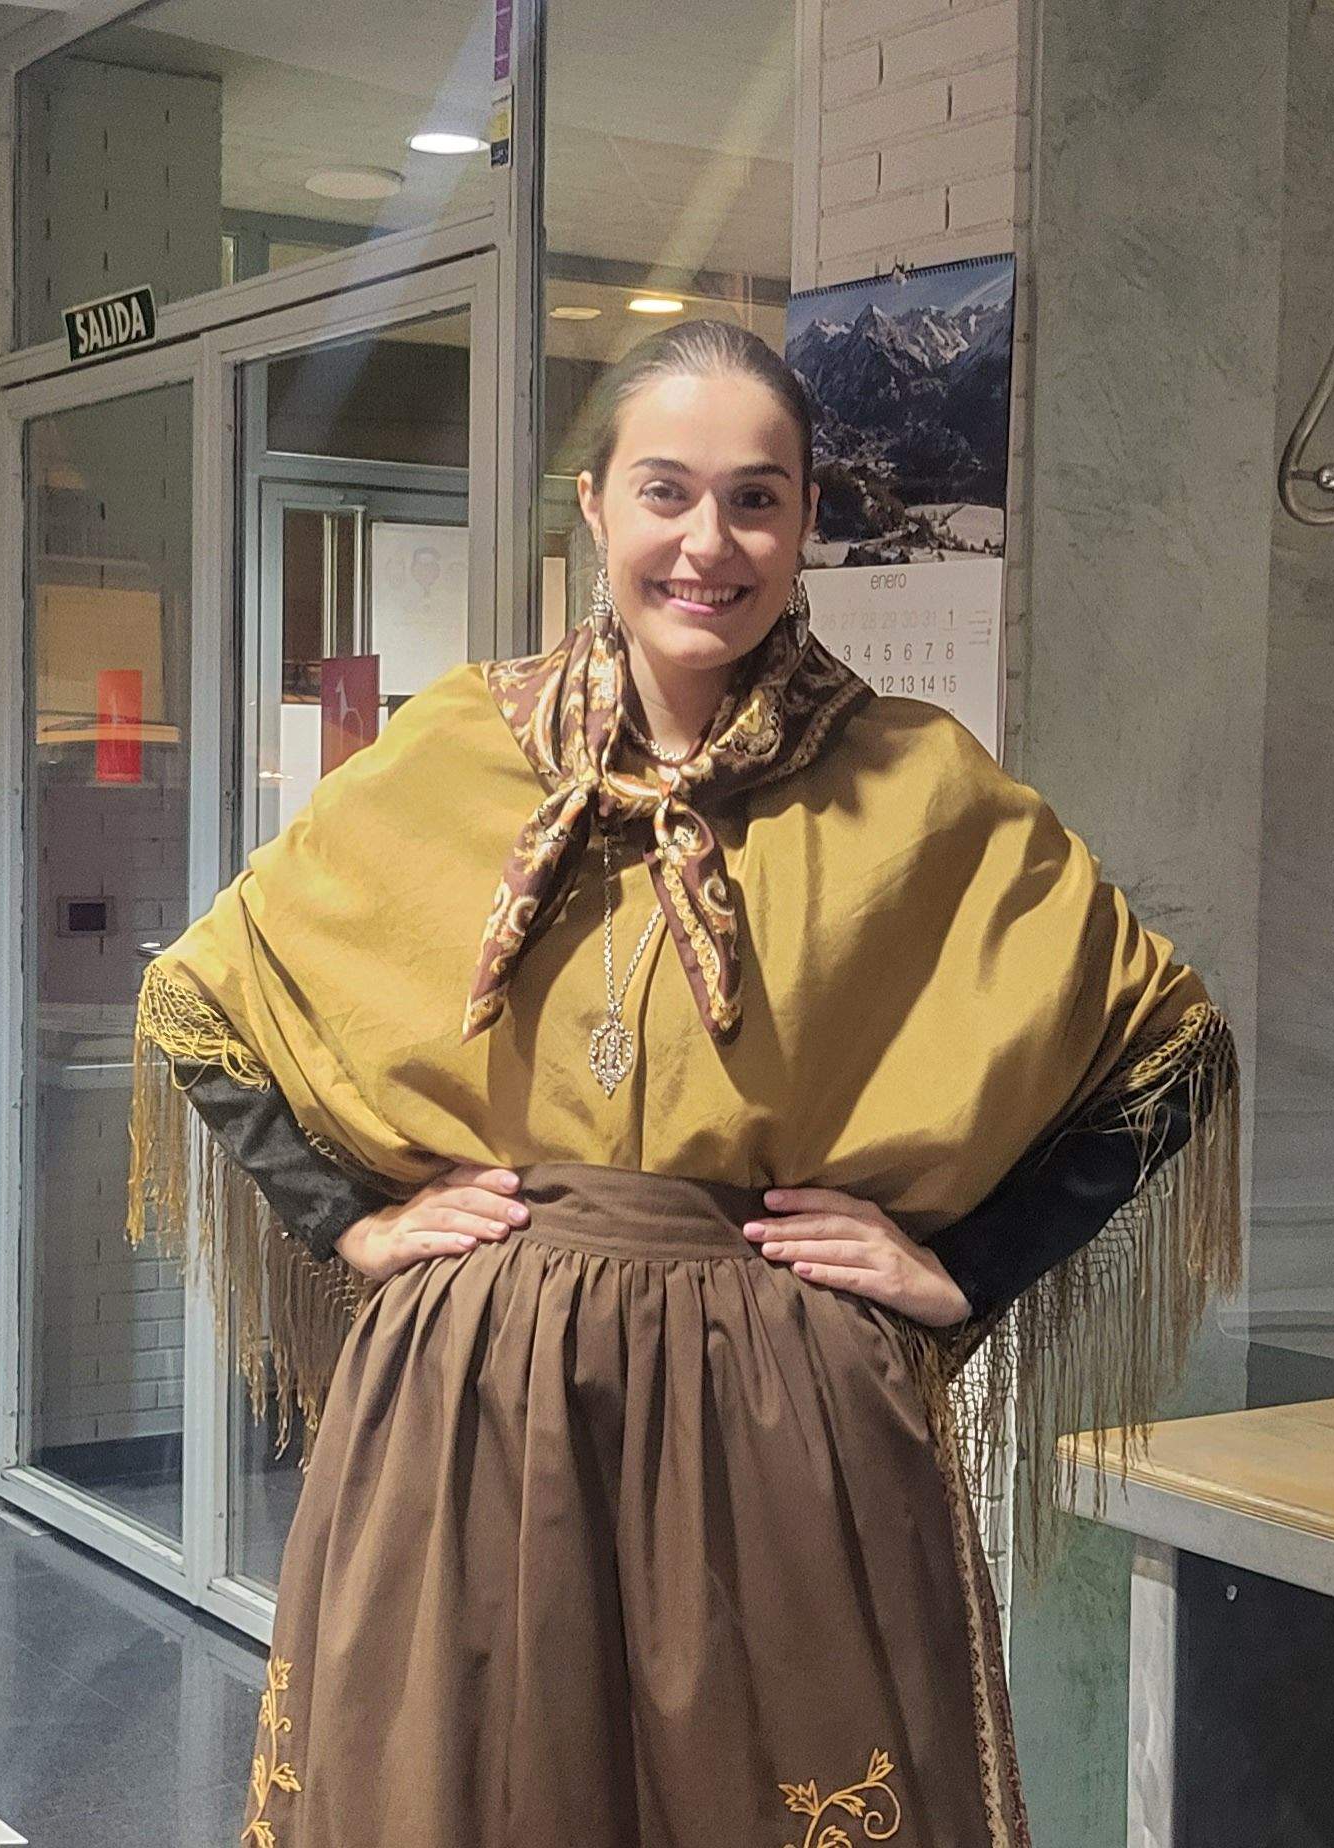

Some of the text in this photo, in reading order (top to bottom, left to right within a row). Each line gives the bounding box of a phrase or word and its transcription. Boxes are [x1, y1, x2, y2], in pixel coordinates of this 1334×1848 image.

[75, 296, 147, 354] SALIDA
[870, 573, 907, 590] enero
[948, 608, 954, 627] 1
[843, 641, 955, 662] 3 4 5 6 7 8
[880, 675, 894, 693] 12
[901, 675, 915, 693] 13
[921, 675, 935, 693] 14
[942, 675, 957, 693] 15
